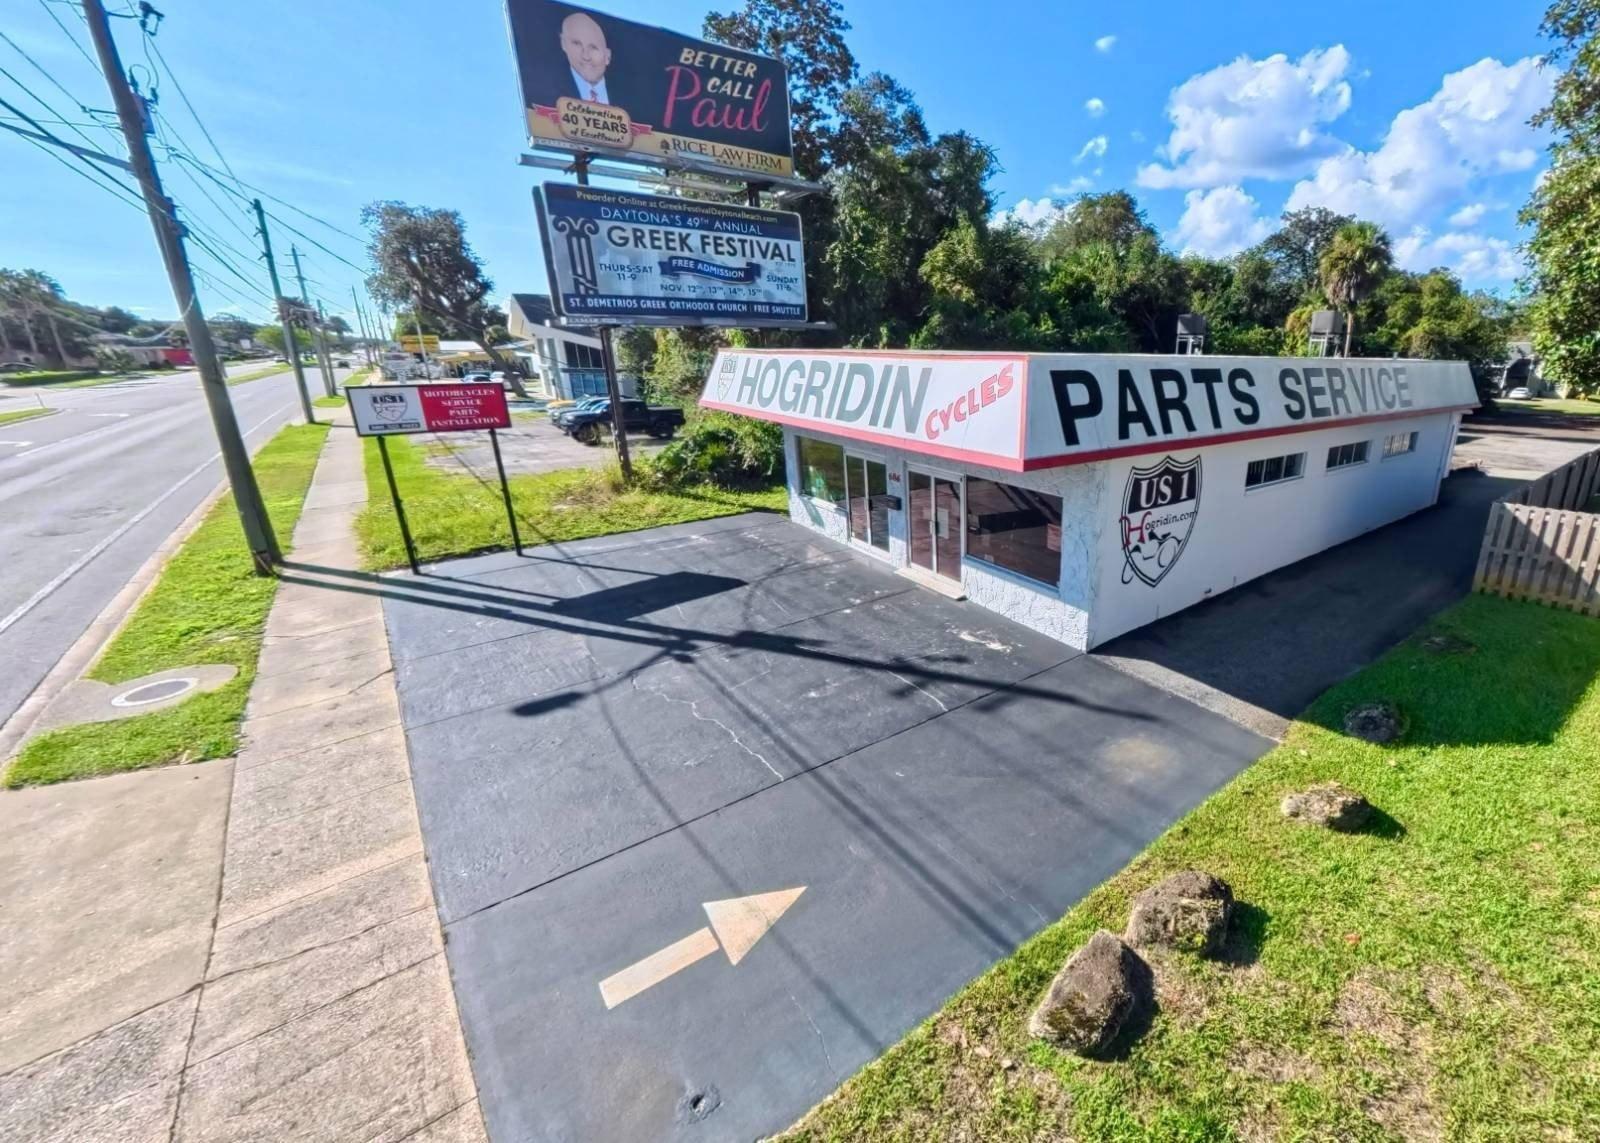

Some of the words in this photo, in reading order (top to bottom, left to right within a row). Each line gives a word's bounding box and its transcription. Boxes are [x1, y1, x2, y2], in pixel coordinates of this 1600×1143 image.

[680, 48, 757, 78] BETTER
[707, 77, 753, 99] CALL
[663, 65, 772, 132] Paul
[566, 102, 623, 123] Celebrating
[562, 113, 579, 126] 40
[583, 117, 628, 134] YEARS
[570, 128, 579, 137] of
[671, 138, 709, 156] RICE
[711, 145, 744, 160] LAW
[747, 151, 783, 170] FIRM
[575, 190, 616, 203] Preorder
[618, 195, 648, 208] Online
[649, 200, 657, 208] at
[601, 206, 682, 226] DAYTONA'S
[713, 220, 763, 236] ANNUAL
[607, 225, 694, 253] GREEK
[700, 234, 796, 263] FESTIVAL
[599, 263, 653, 274] THURS-SAT
[616, 273, 637, 281] 11-9
[671, 259, 695, 269] FREE
[697, 263, 745, 278] ADMISSION
[660, 284, 684, 292] NOV.
[766, 274, 799, 285] SUNDAY
[569, 298, 585, 308] ST.
[587, 298, 638, 308] DEMETRIOS
[640, 299, 667, 309] GREEK
[669, 300, 715, 311] ORTHODOX
[716, 302, 748, 312] CHURCH
[753, 304, 770, 313] FREE
[771, 305, 800, 315] SHUTTLE
[423, 388, 495, 398] MOTORCYCLES
[441, 398, 483, 407] SERVICE
[736, 357, 933, 435] HOGRIDIN
[924, 362, 1014, 441] CYCLES
[448, 408, 480, 416] PARTS
[1050, 367, 1260, 446] PARTS
[1279, 366, 1413, 420] SERVICE
[431, 416, 500, 427] INSTALLATION
[1139, 474, 1173, 509] US
[1180, 471, 1190, 501] 1
